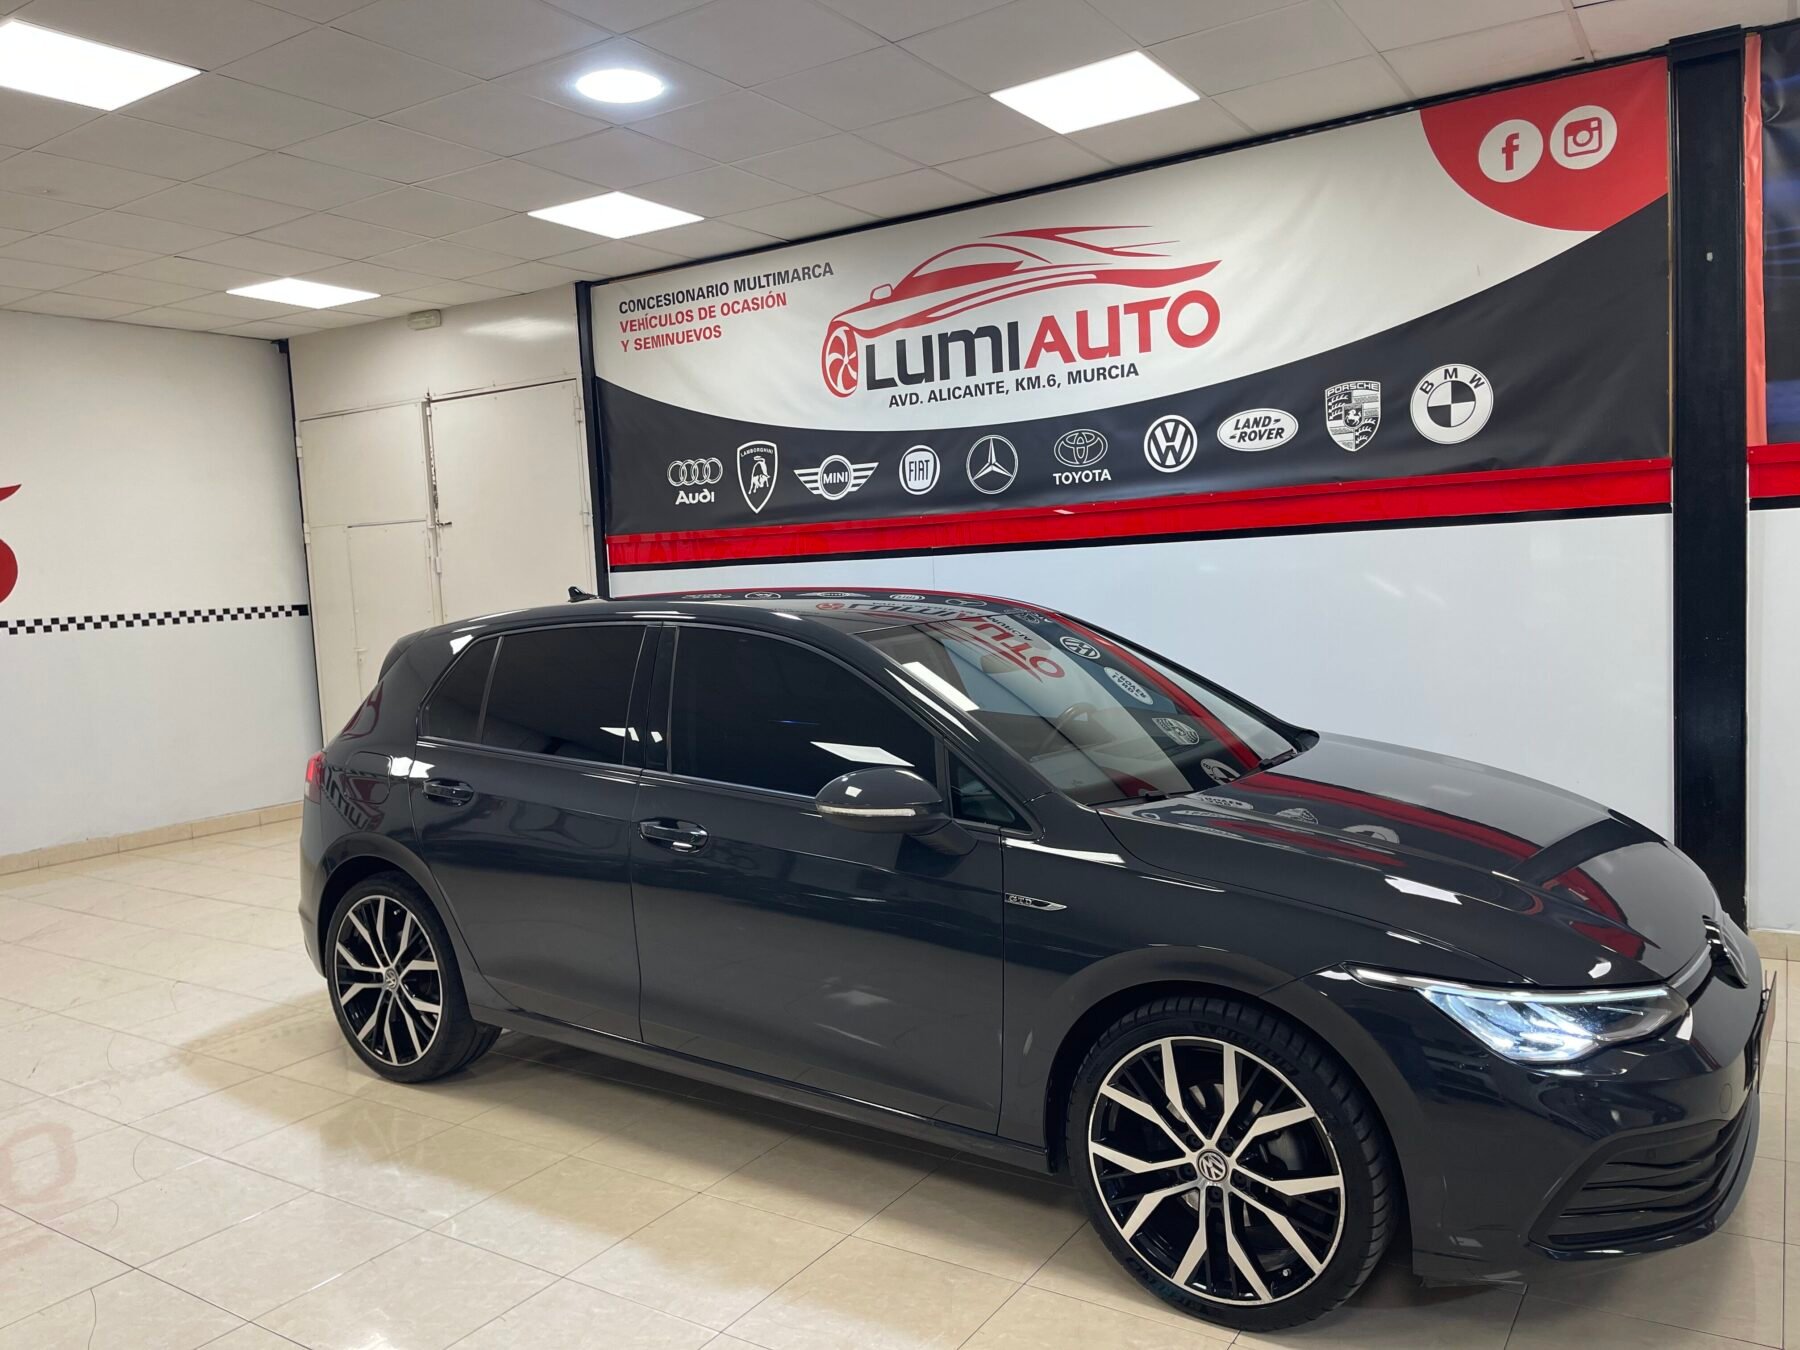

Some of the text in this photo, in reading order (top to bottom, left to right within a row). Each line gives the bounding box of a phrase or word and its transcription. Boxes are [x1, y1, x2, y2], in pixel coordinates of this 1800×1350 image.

[619, 262, 834, 314] CONCESIONARIO MULTIMARCA
[620, 291, 787, 333] VEHÍCULOS DE OCASIÓN
[621, 325, 722, 352] Y SEMINUEVOS
[888, 362, 1140, 408] AVD. ALICANTE, KM.6, MURCIA
[1327, 382, 1379, 397] PORSCHE
[1419, 367, 1485, 394] BMW
[823, 471, 849, 484] MINI
[908, 459, 931, 482] FIAT
[1053, 469, 1111, 485] TOYOTA
[675, 489, 715, 505] Audi
